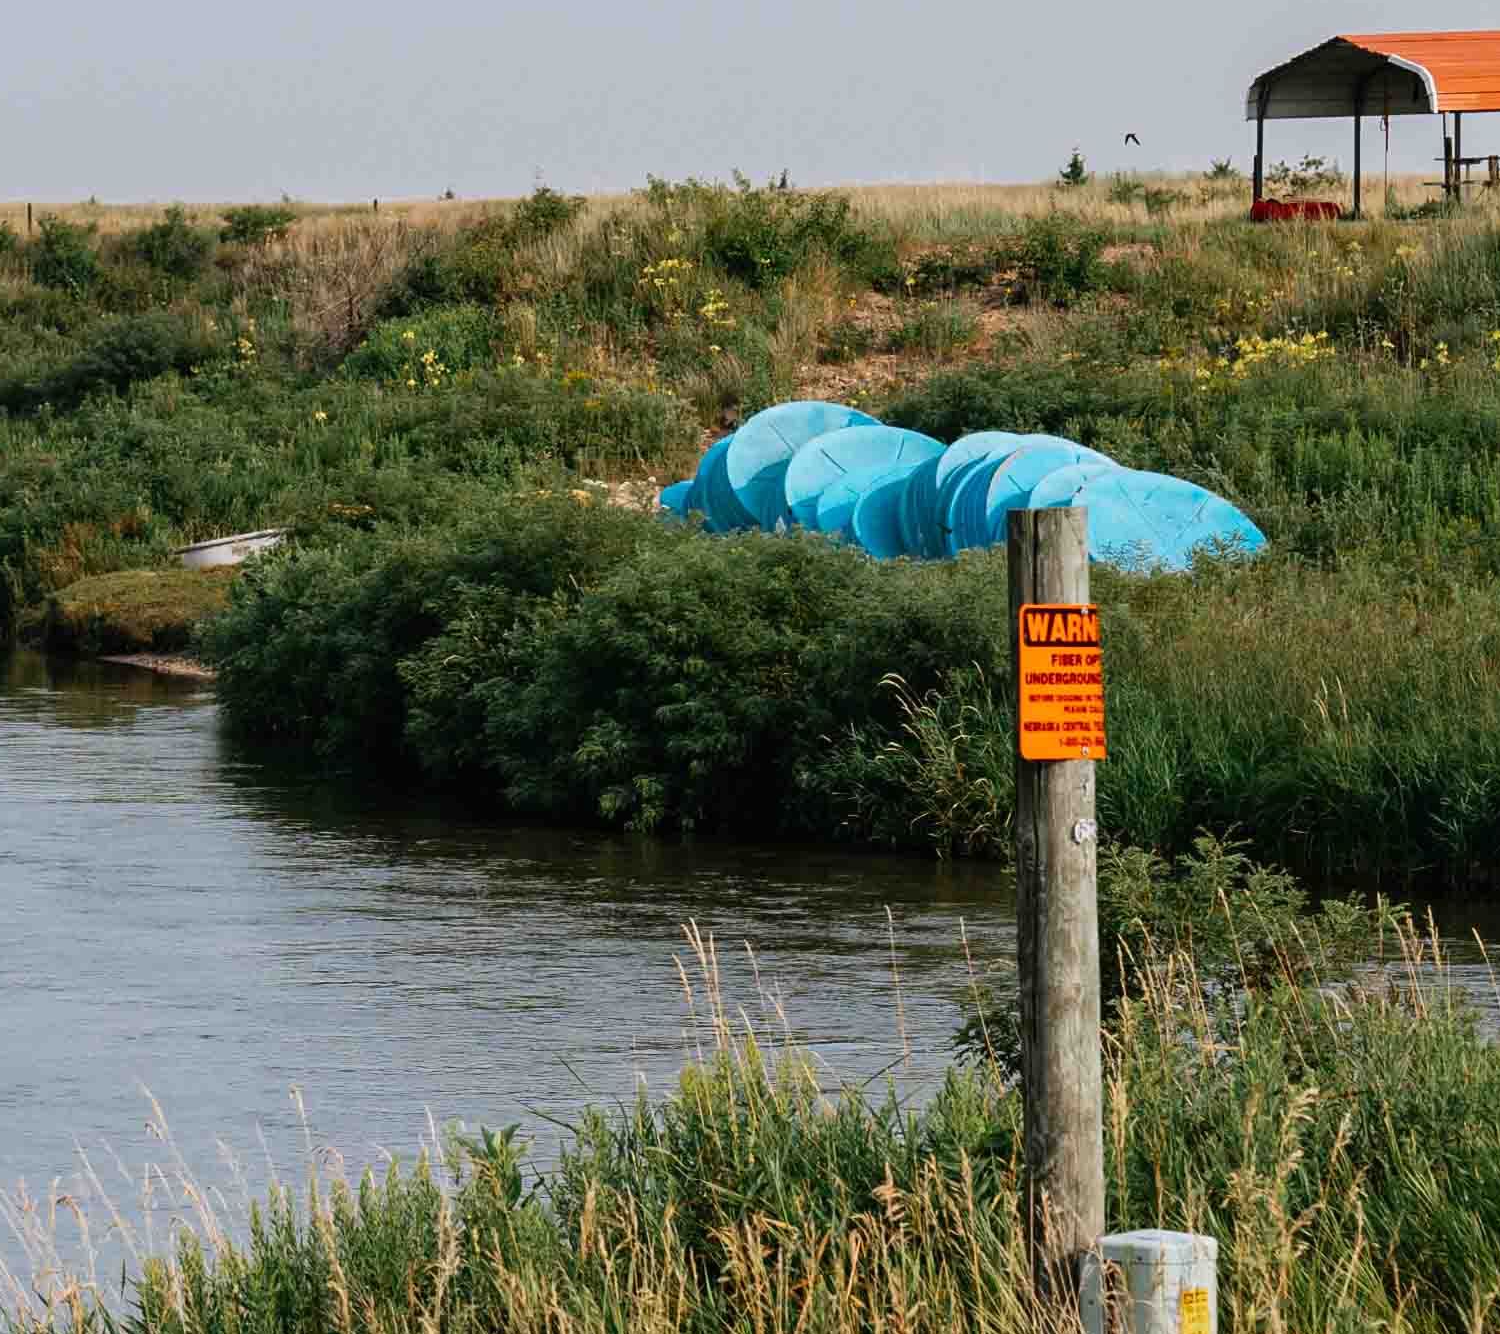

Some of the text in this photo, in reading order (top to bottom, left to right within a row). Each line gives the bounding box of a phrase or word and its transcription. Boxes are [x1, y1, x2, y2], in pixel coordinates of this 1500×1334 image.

[1027, 612, 1098, 643] WARN
[1051, 653, 1083, 667] FIBER
[1025, 672, 1102, 685] UNDERGROUN
